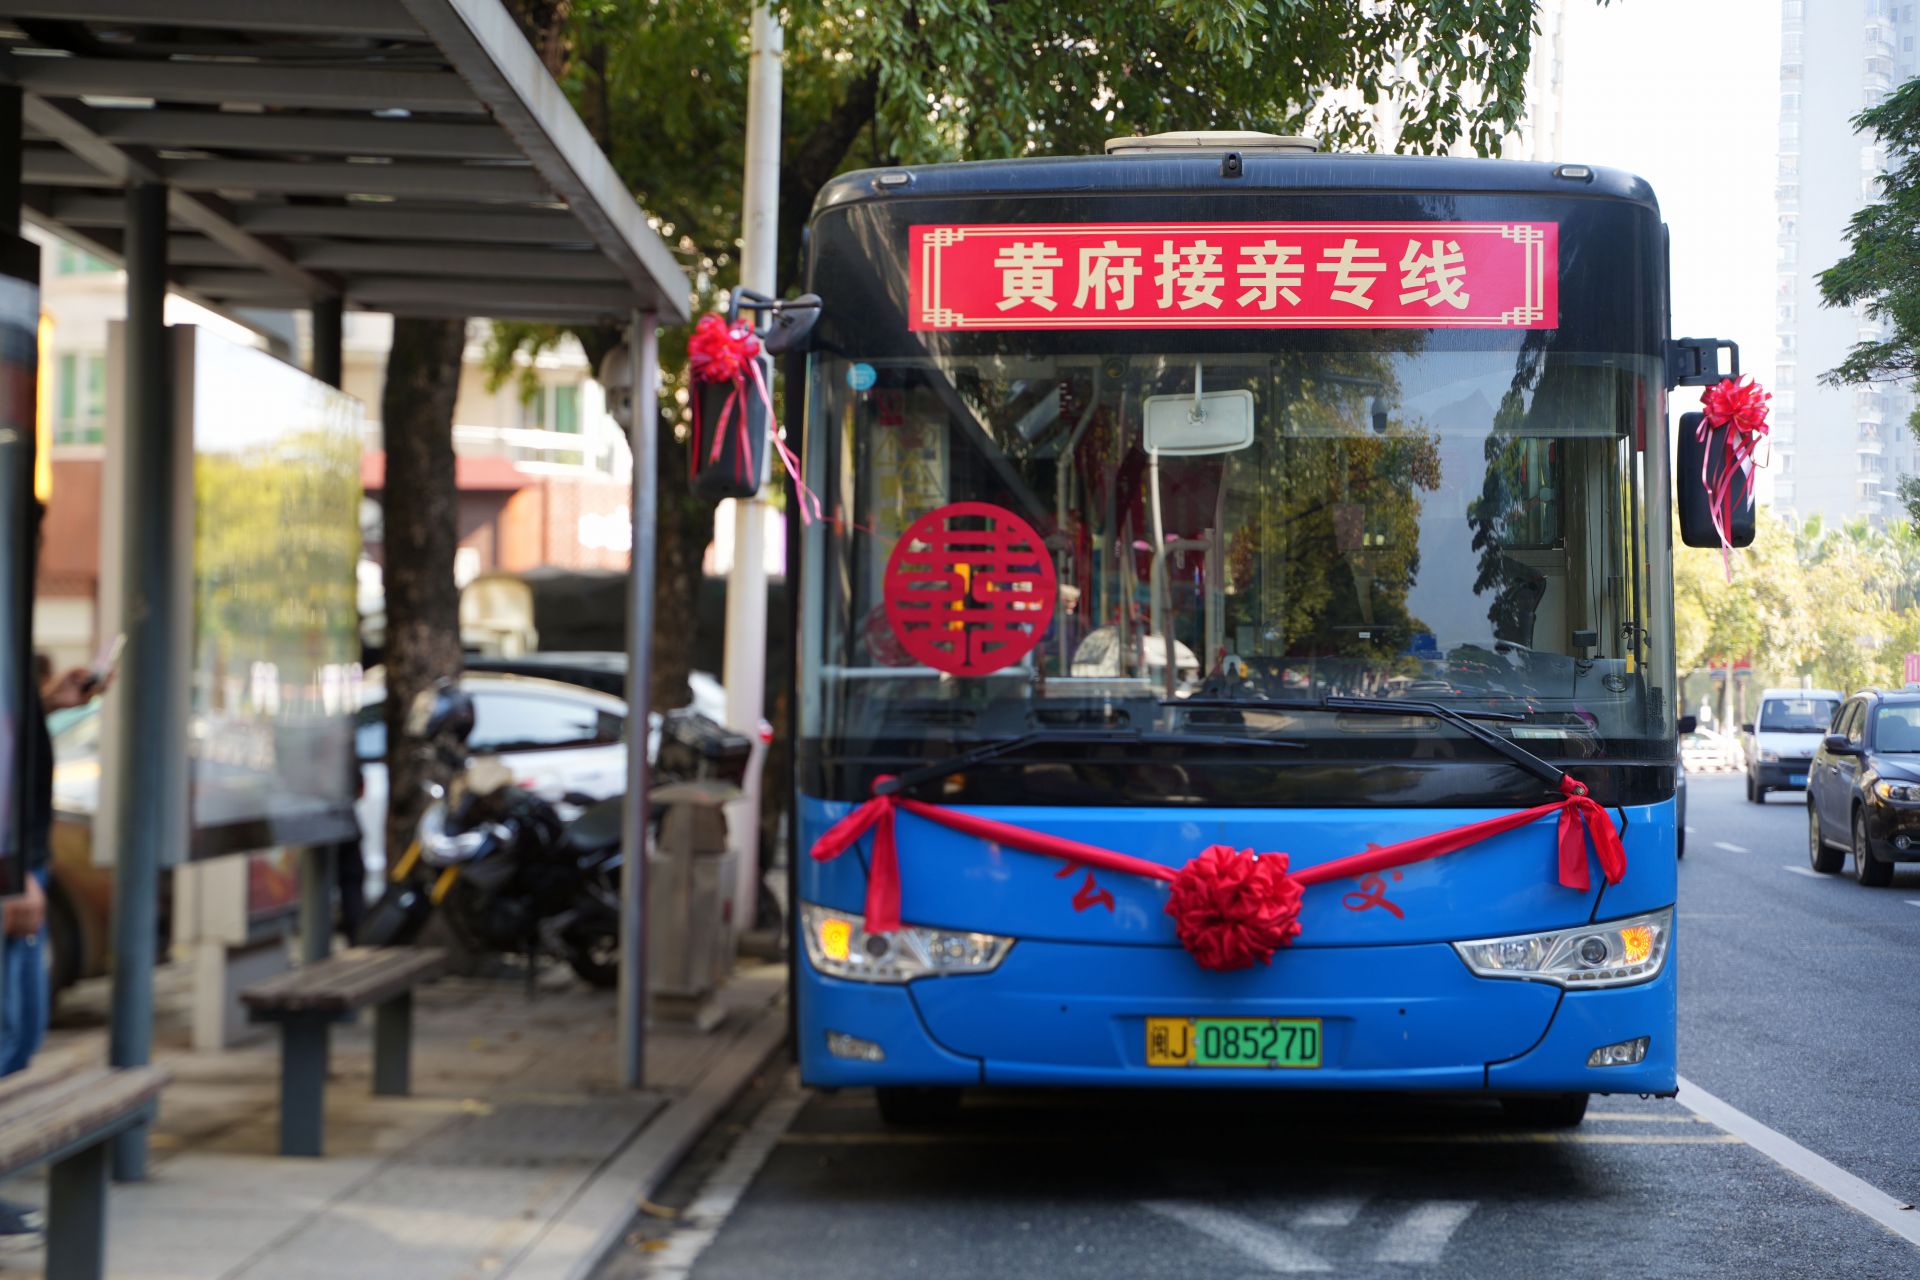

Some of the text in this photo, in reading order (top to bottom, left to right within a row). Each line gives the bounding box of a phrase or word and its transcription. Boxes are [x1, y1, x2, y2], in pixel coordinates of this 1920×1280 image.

[994, 238, 1470, 312] 黄府接亲专线
